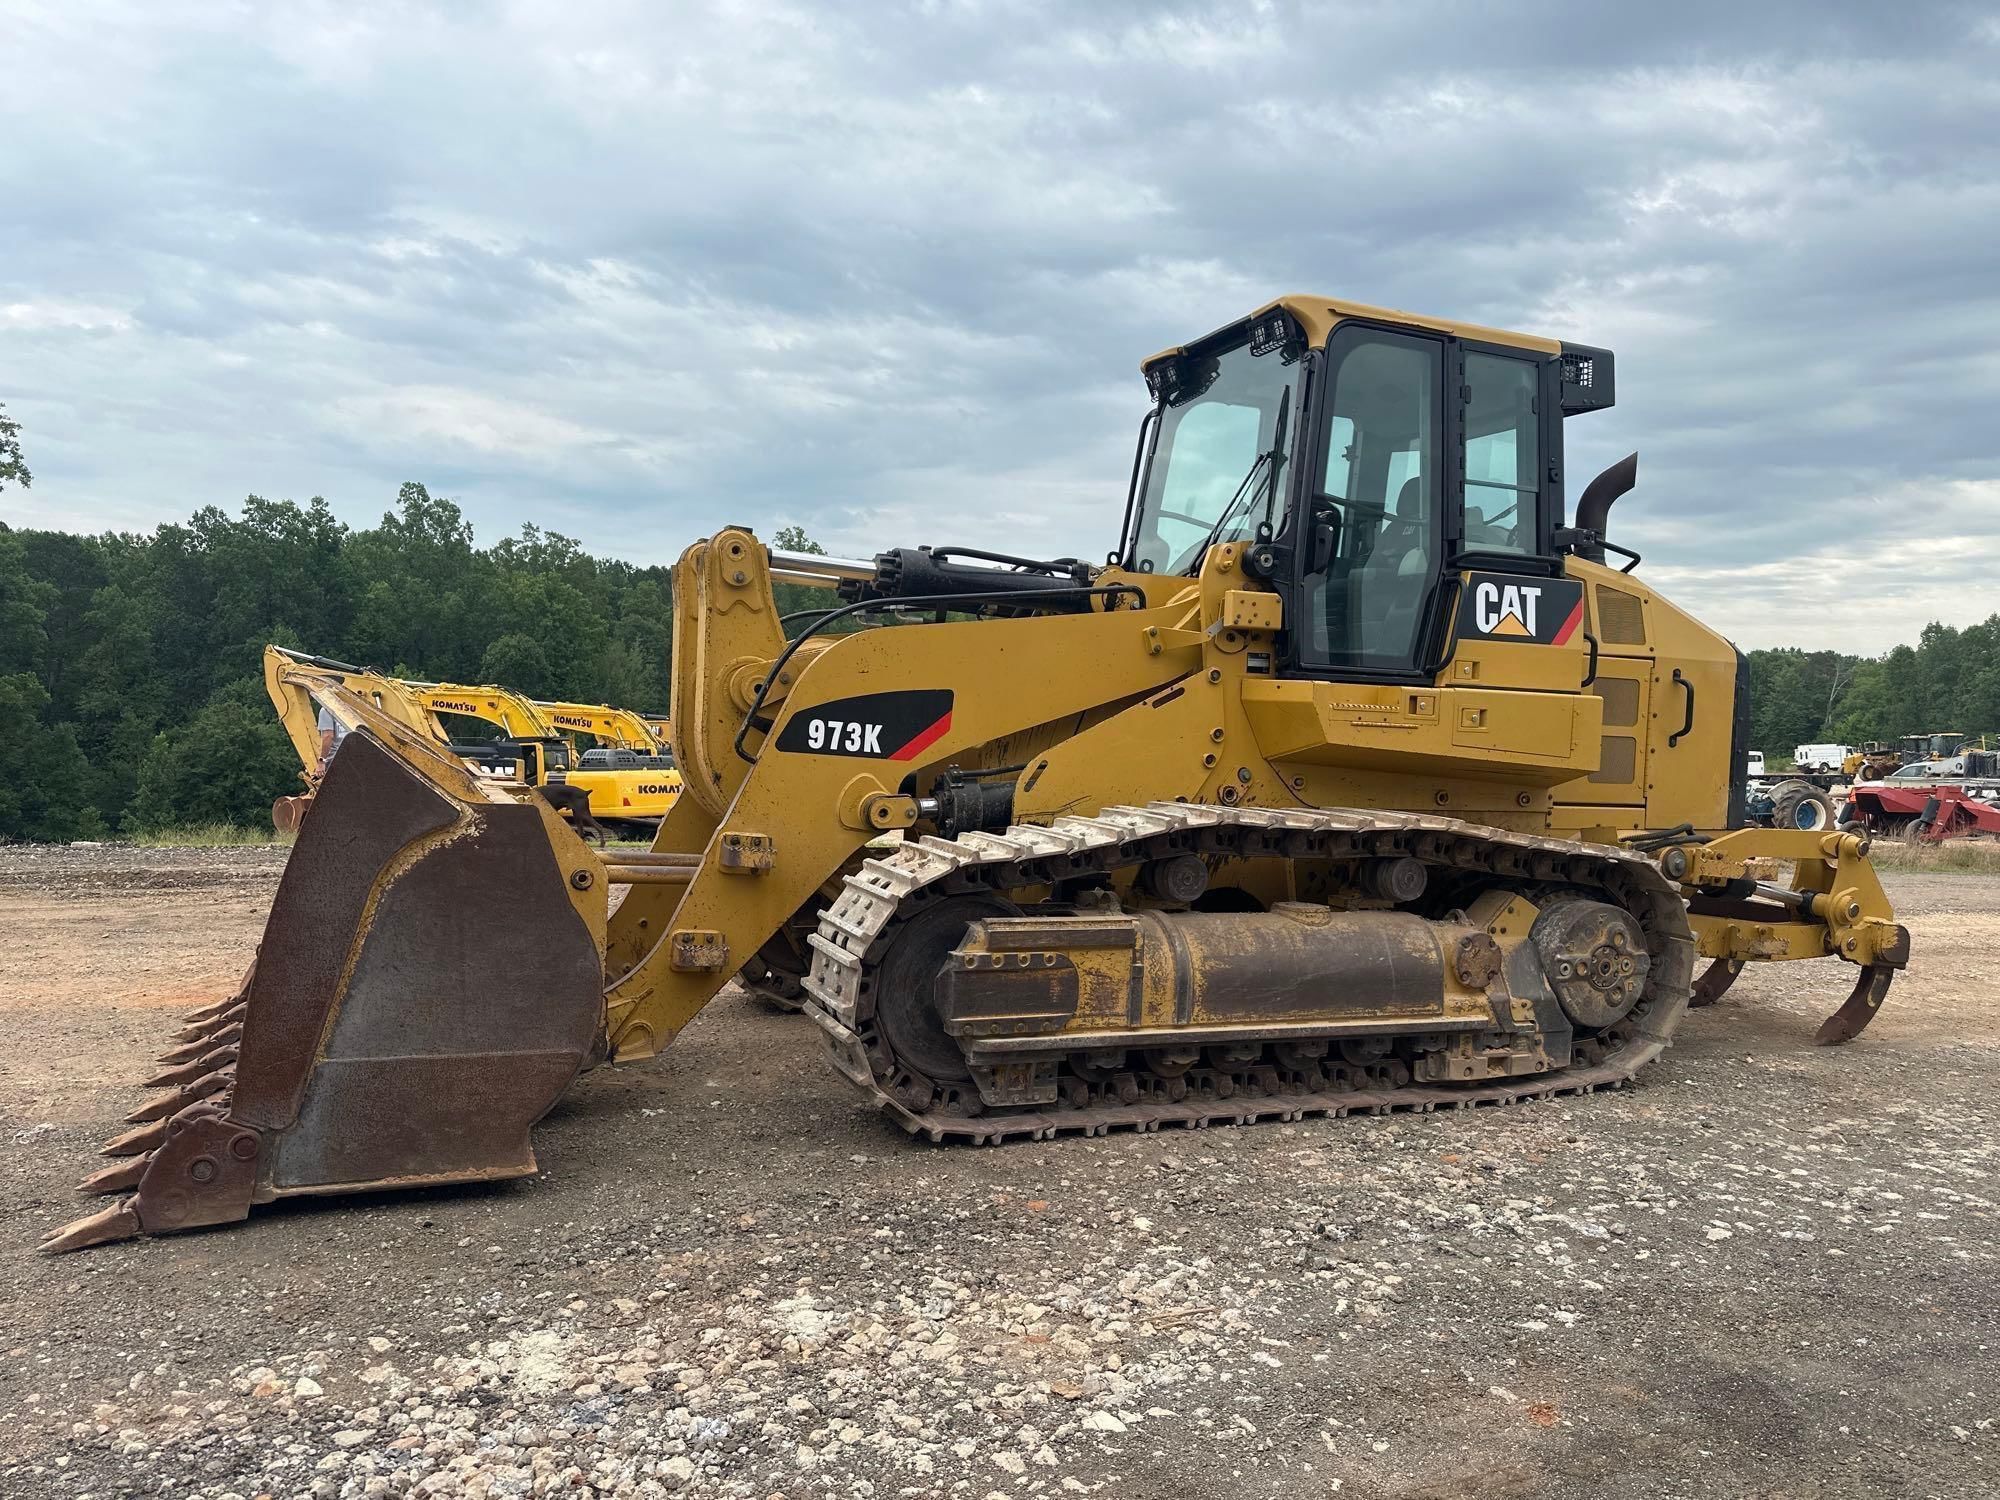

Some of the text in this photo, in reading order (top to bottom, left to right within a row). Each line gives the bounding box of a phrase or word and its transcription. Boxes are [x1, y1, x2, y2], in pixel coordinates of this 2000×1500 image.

[1476, 582, 1542, 636] CAT
[432, 700, 476, 712] KOMATSU
[553, 715, 592, 728] KOMATSU
[649, 726, 660, 735] AT
[808, 719, 883, 753] 973K
